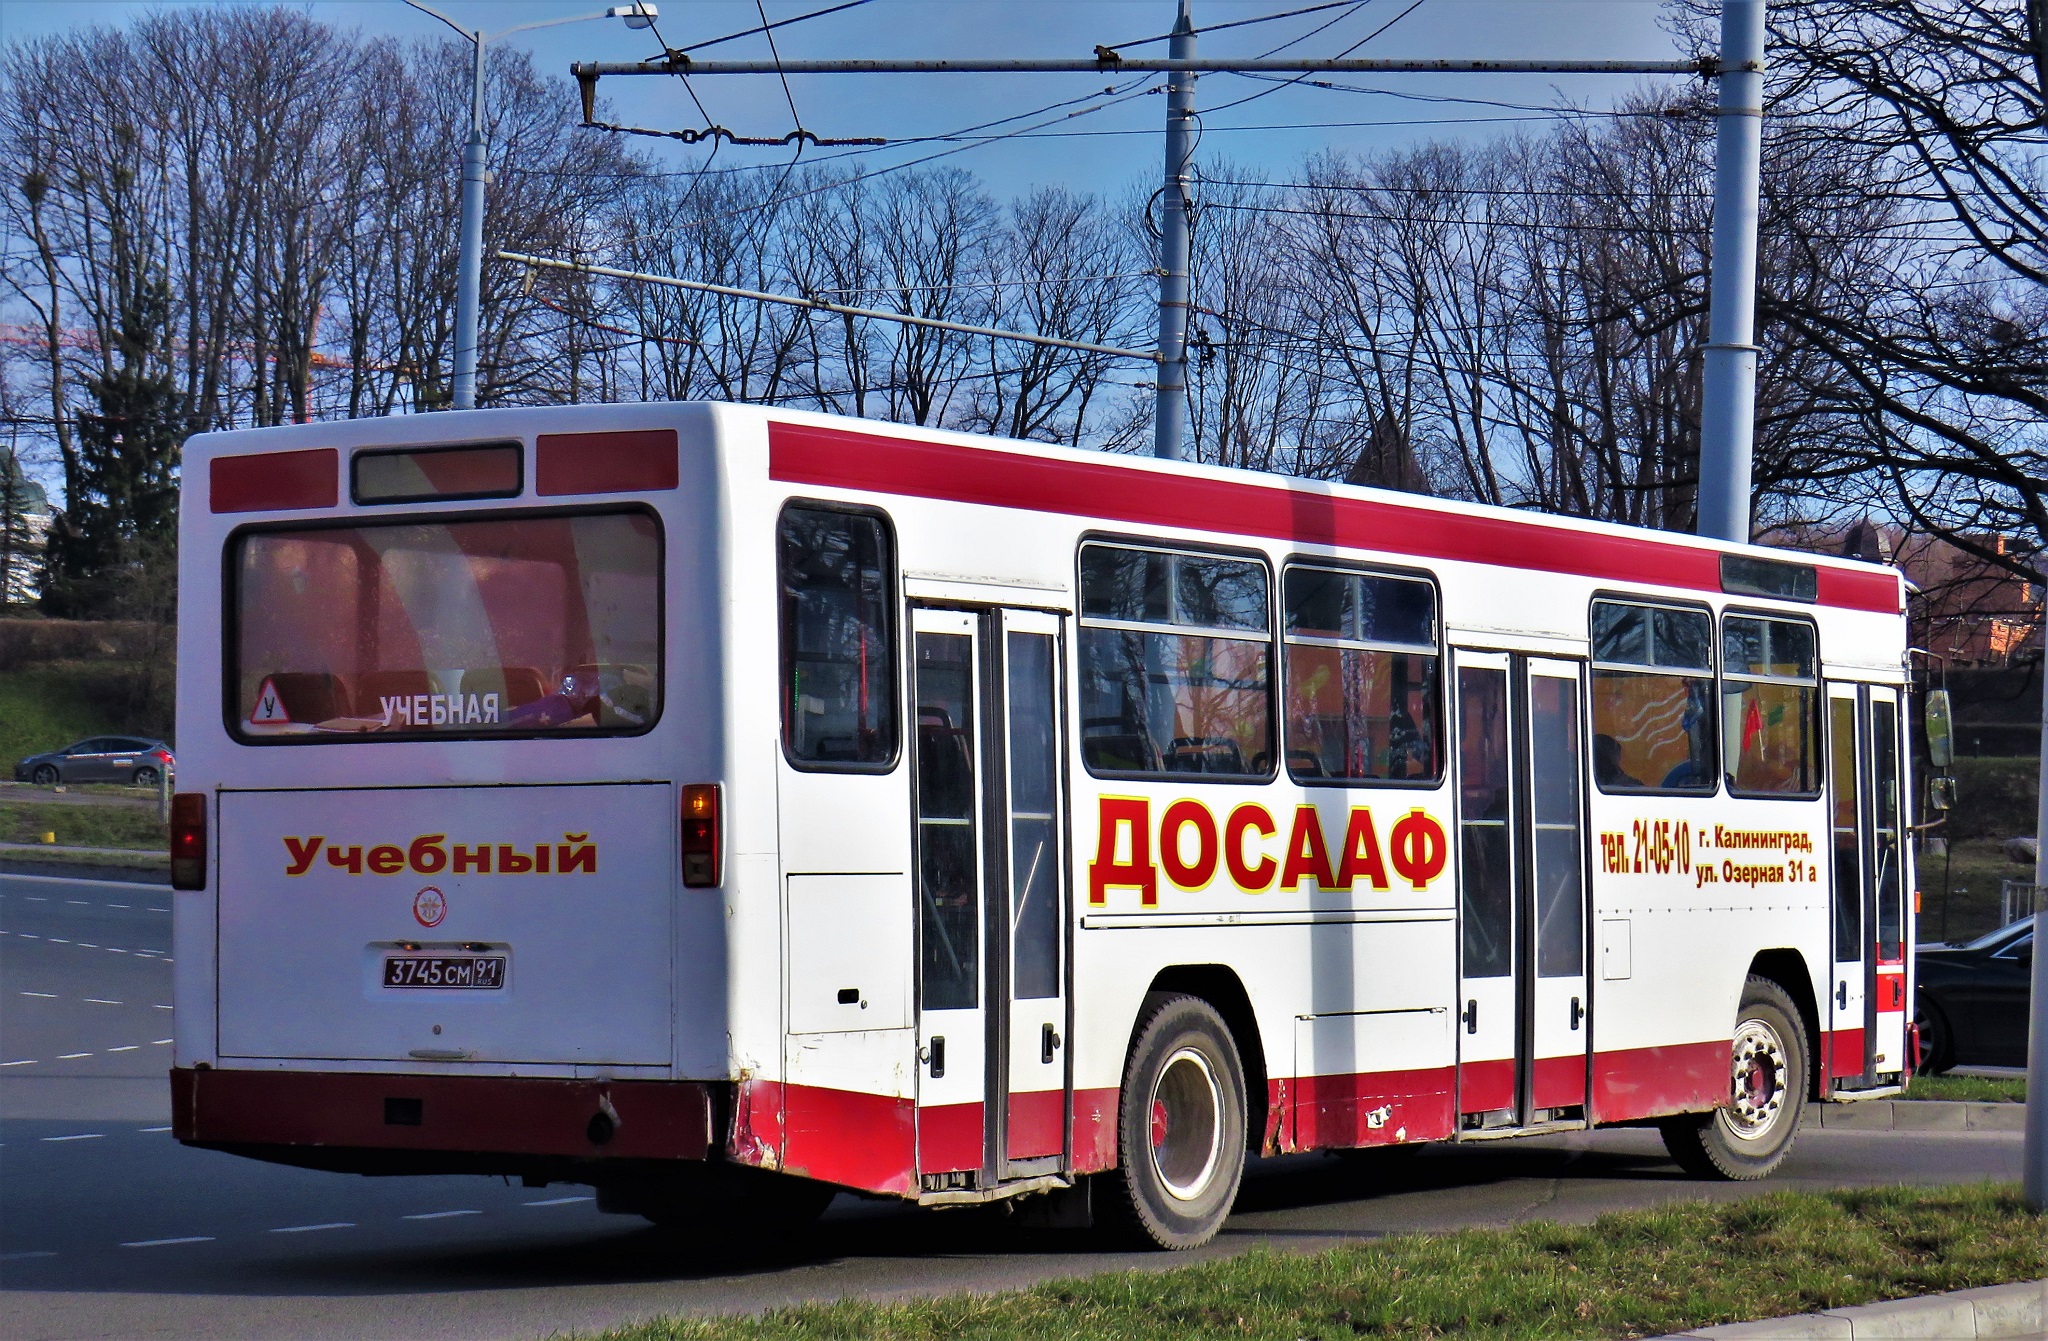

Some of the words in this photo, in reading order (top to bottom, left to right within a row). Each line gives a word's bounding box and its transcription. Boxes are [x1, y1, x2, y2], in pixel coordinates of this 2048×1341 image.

[264, 696, 275, 718] У
[380, 693, 499, 726] УЧЕБНАЯ
[282, 831, 598, 876] Учебный
[1087, 793, 1448, 909] ДОСААФ
[1600, 831, 1630, 874] тел.
[1632, 817, 1690, 875] 21-05-10
[1698, 829, 1710, 848] г.
[1713, 823, 1813, 854] Калининград,
[1695, 863, 1719, 889] ул.
[1722, 858, 1784, 889] Озерная
[1788, 860, 1804, 882] 31
[1808, 866, 1817, 882] а
[476, 960, 497, 978] 91
